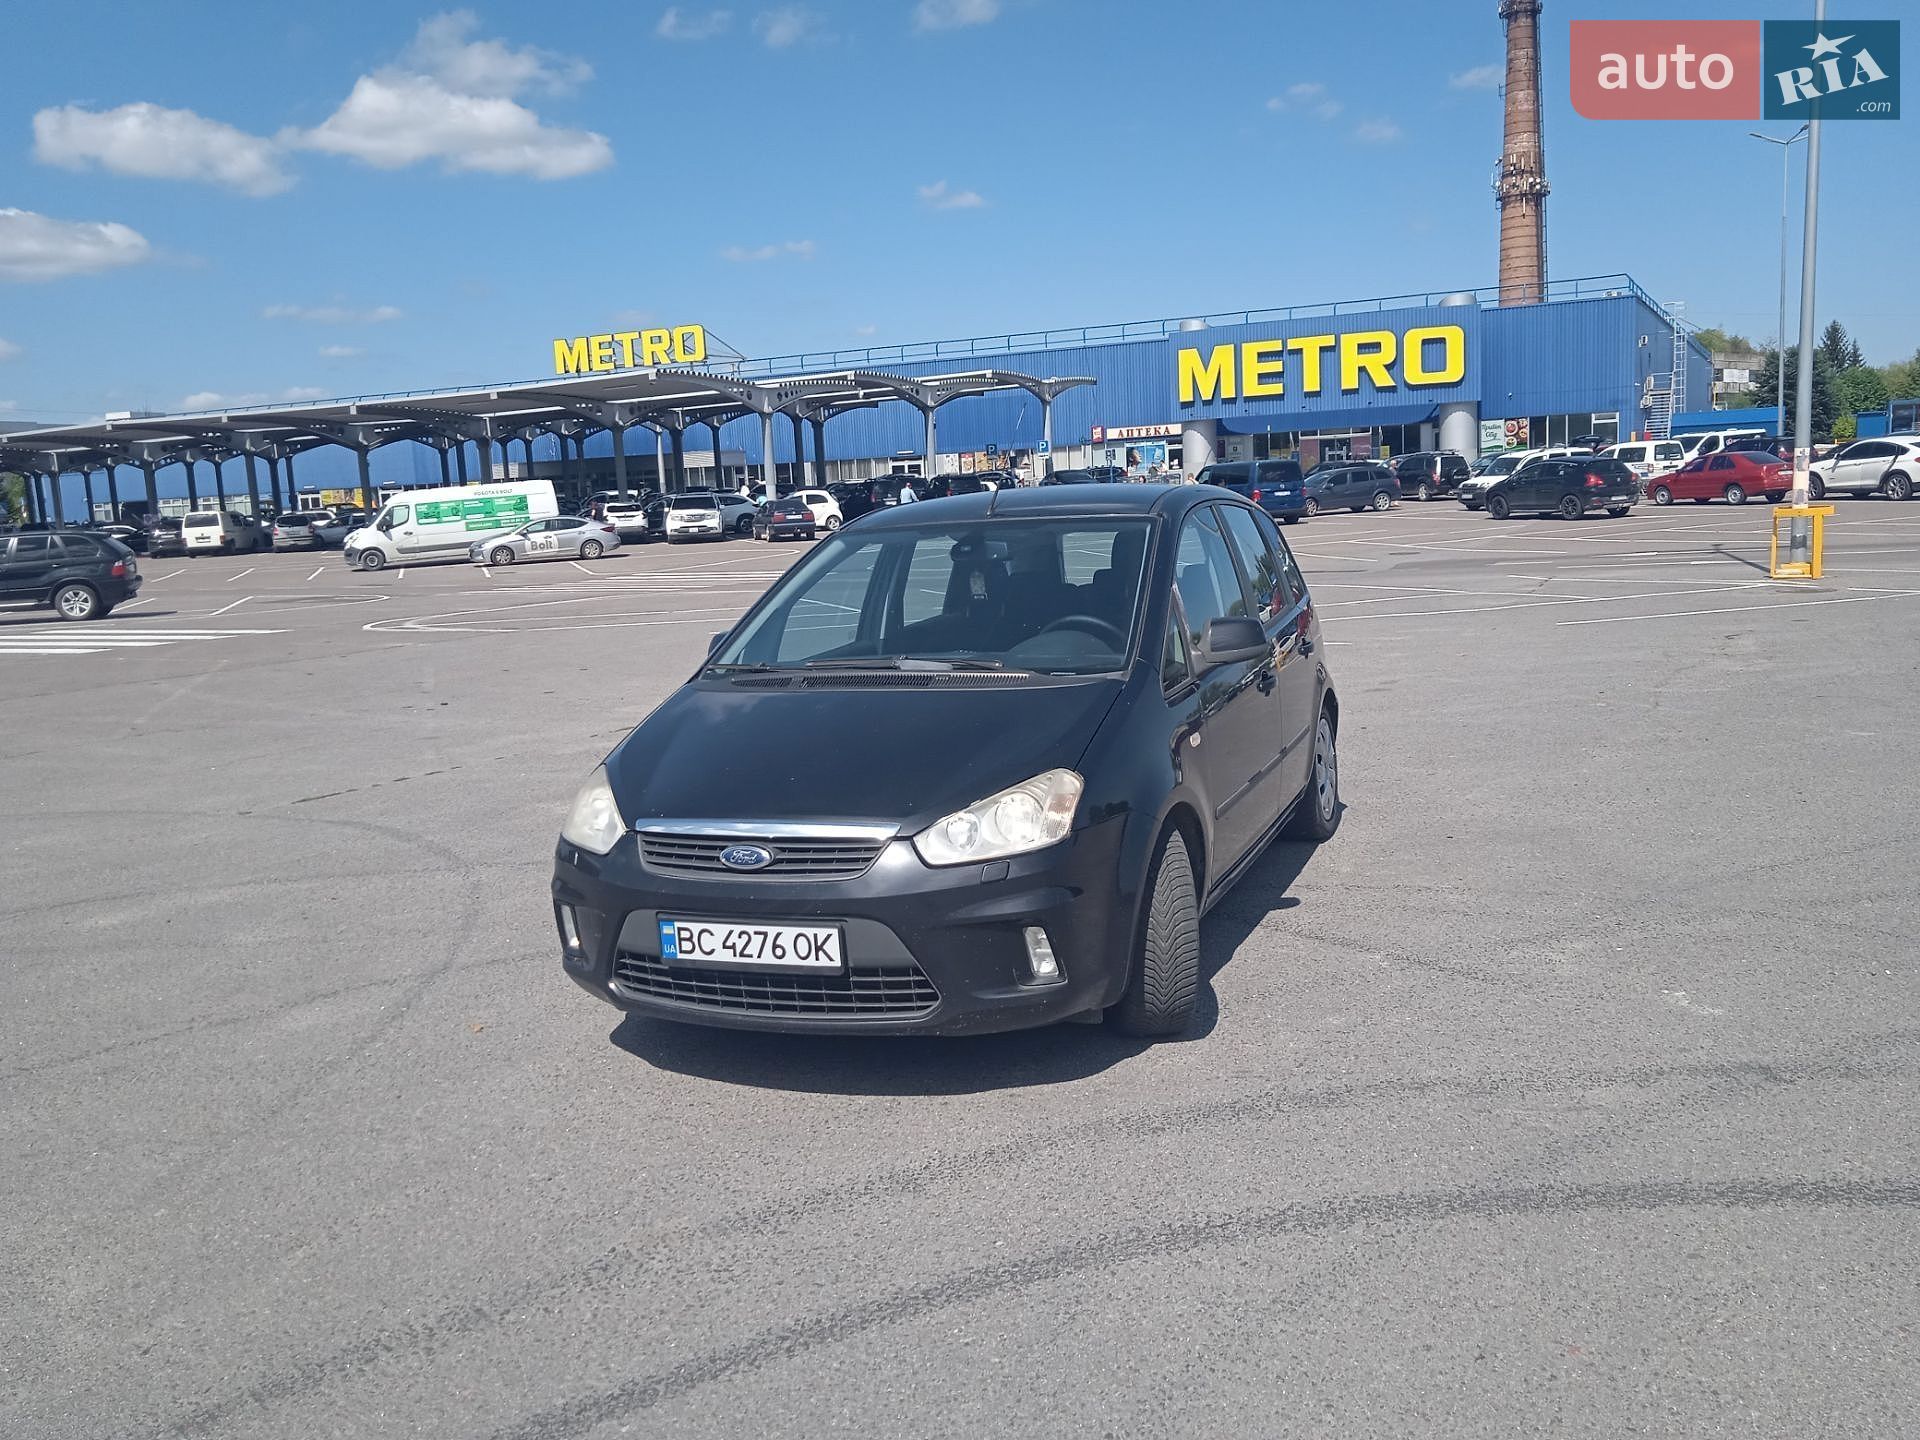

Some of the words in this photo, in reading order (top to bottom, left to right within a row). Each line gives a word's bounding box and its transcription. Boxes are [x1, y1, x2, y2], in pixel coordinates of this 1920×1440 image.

[553, 324, 707, 375] METRO
[1178, 325, 1466, 403] METRO
[1117, 426, 1171, 438] АПТЕКА
[530, 540, 553, 551] Bolt
[730, 849, 758, 864] Ford
[664, 944, 676, 953] UA
[677, 926, 716, 956] BC
[722, 929, 787, 960] 4276
[793, 932, 835, 962] OK
